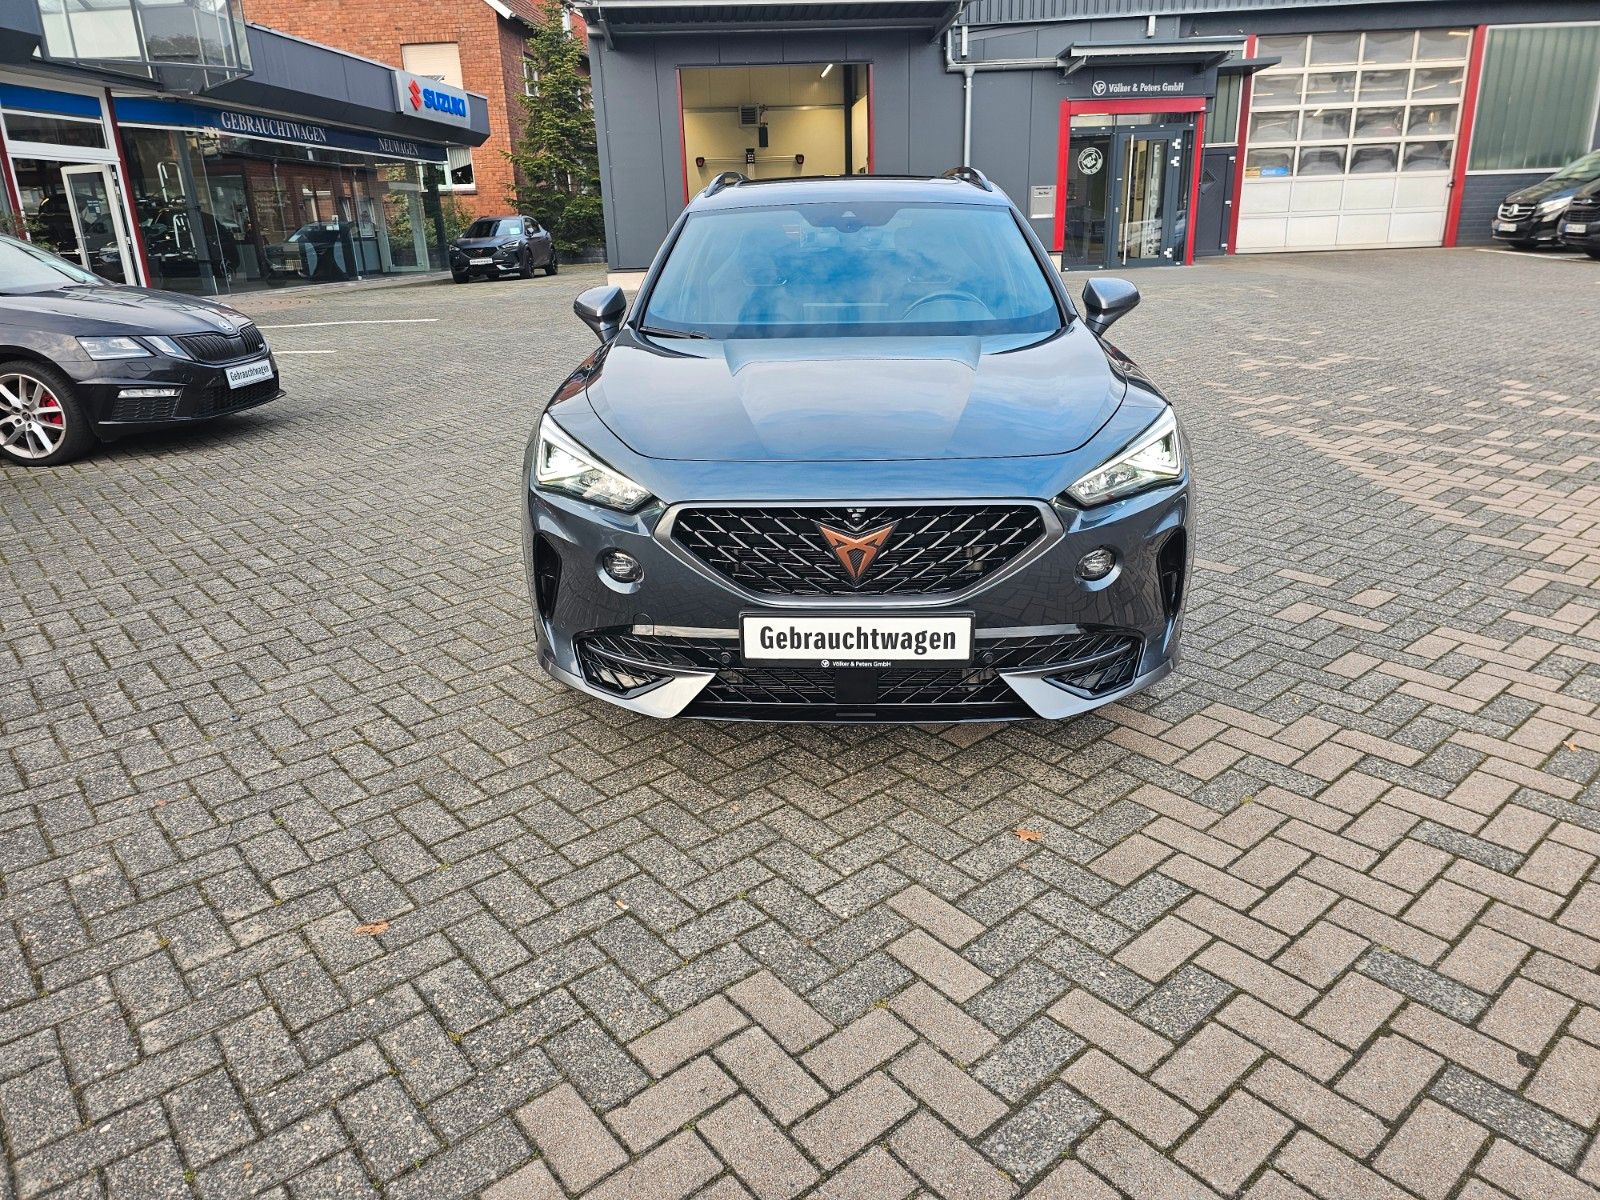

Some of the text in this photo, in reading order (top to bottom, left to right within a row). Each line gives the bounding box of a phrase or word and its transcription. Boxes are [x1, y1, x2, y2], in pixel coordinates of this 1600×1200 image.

[1109, 82, 1131, 93] Völker
[1132, 83, 1138, 92] &
[1140, 83, 1160, 92] Peters
[1162, 82, 1184, 92] GmbH
[422, 87, 467, 118] SUZUKI
[221, 111, 327, 143] GEBRAUCHTWAGEN
[378, 137, 419, 156] NEUWAGEN
[229, 365, 269, 382] Gebrauchtwagen
[759, 625, 956, 656] Gebrauchtwagen
